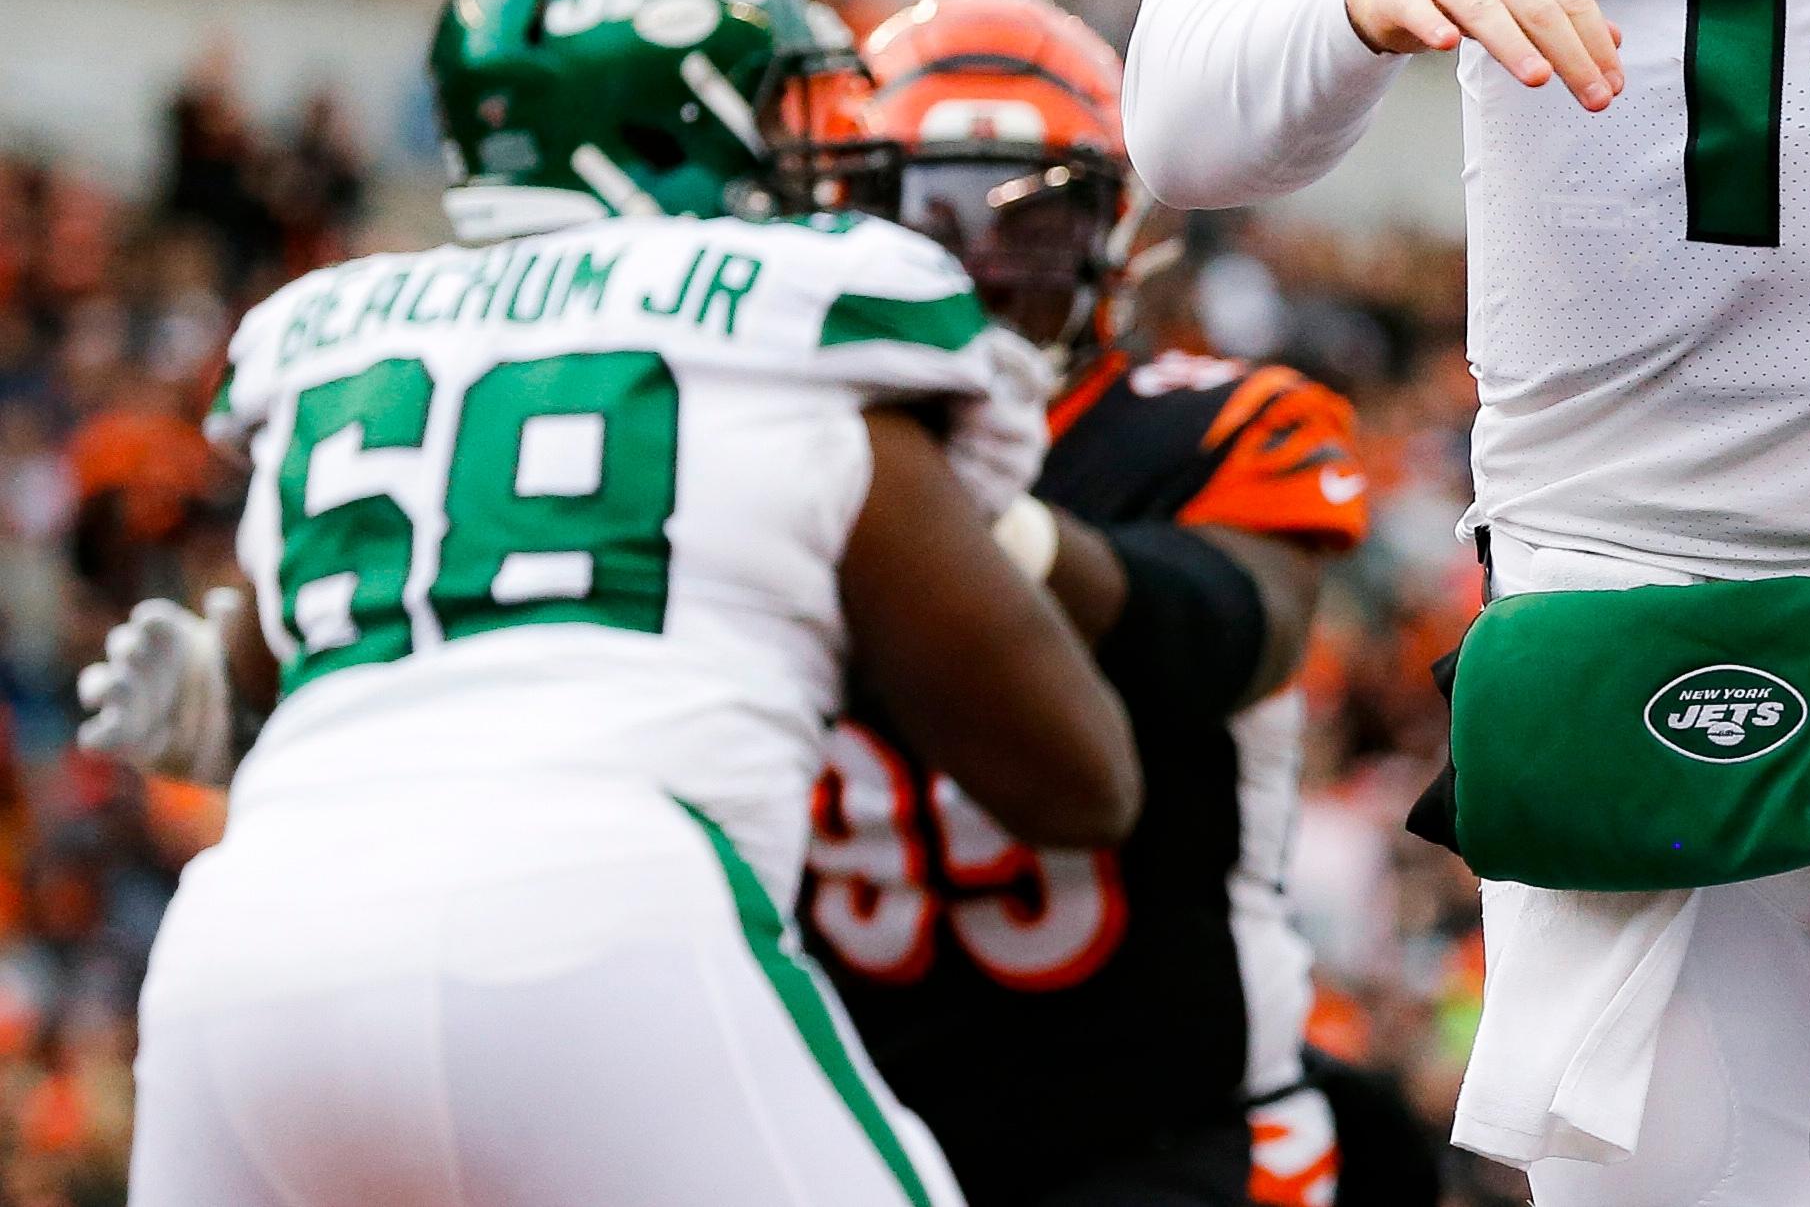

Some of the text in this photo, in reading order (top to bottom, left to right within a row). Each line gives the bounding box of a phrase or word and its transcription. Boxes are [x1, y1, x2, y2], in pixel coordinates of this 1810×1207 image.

[277, 243, 763, 370] BEACHUM JR
[277, 350, 680, 700] 68
[1667, 701, 1785, 730] JETS
[1678, 687, 1773, 701] NEW YORK
